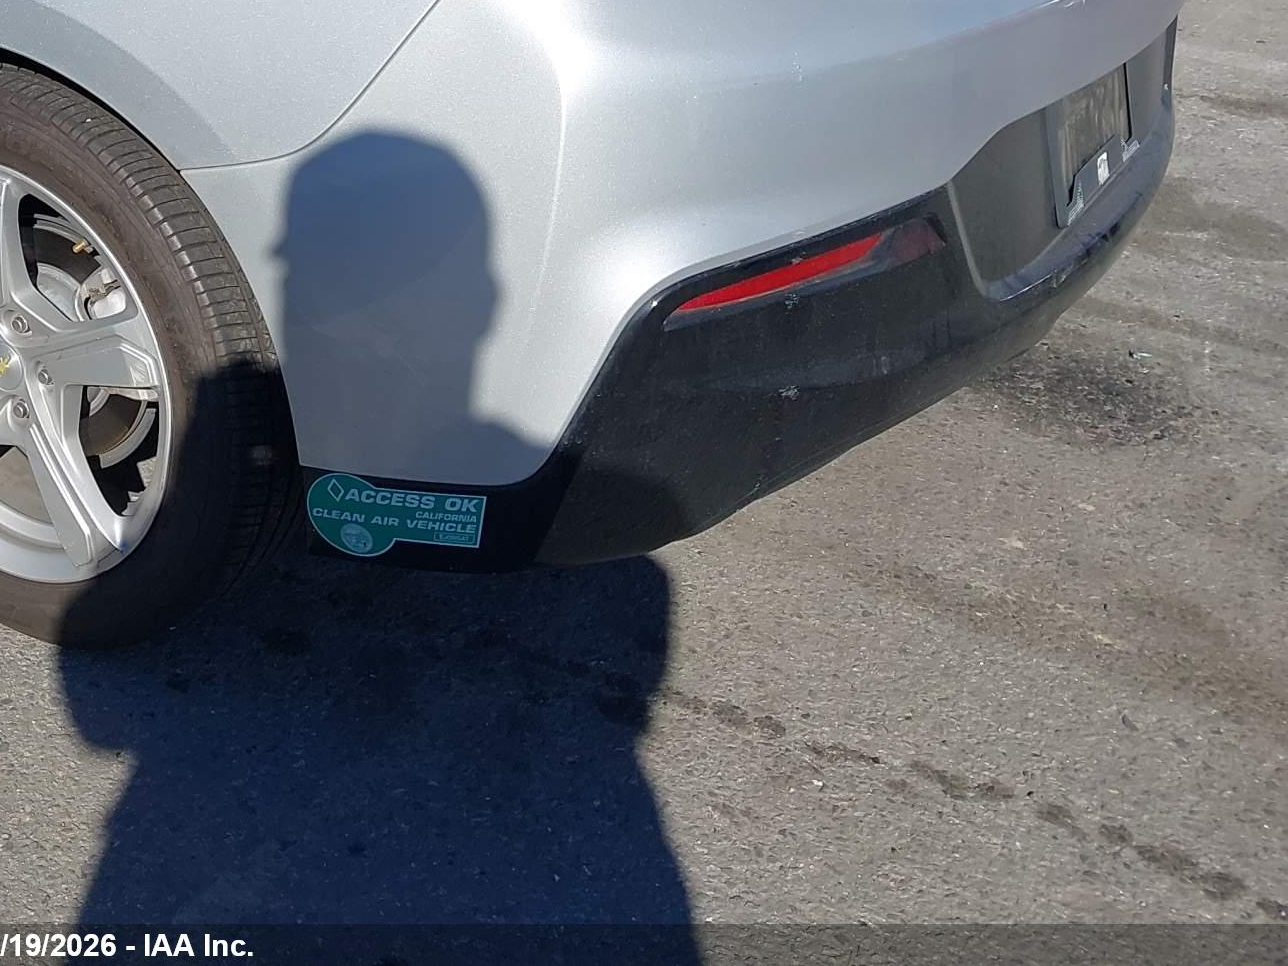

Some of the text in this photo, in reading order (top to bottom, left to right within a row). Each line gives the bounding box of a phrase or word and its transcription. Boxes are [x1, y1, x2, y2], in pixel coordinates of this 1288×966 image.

[345, 488, 480, 513] ACCESS OK
[312, 507, 477, 534] CLEAN AIR VEHICLE
[415, 511, 477, 523] CALIFORNIA
